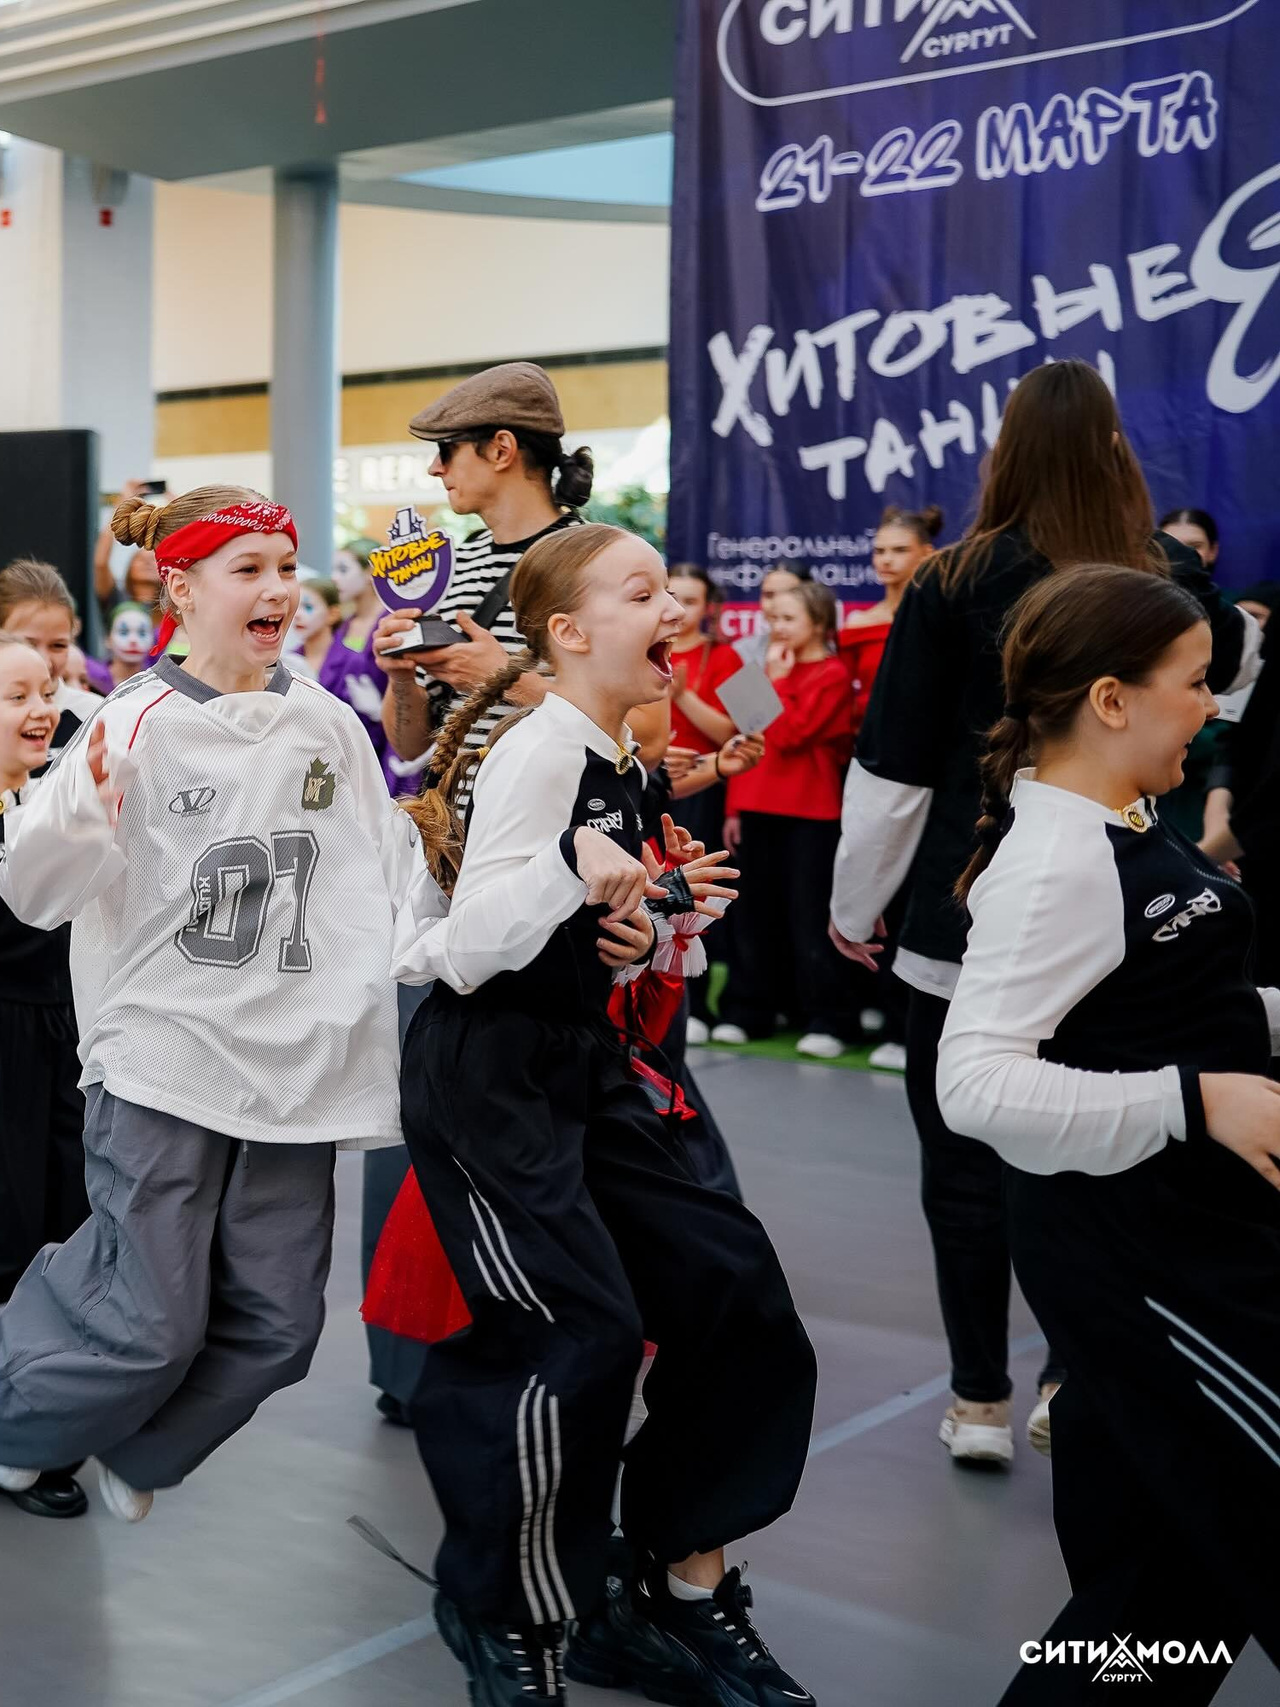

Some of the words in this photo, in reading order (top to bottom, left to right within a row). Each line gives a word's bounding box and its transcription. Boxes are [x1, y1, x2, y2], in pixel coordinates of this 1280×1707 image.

[921, 24, 1014, 58] СУРГУТ
[755, 120, 964, 212] 21-22
[975, 71, 1218, 180] МАРТА
[708, 244, 1209, 447] ХИТОВЫЕ
[174, 830, 321, 973] 07
